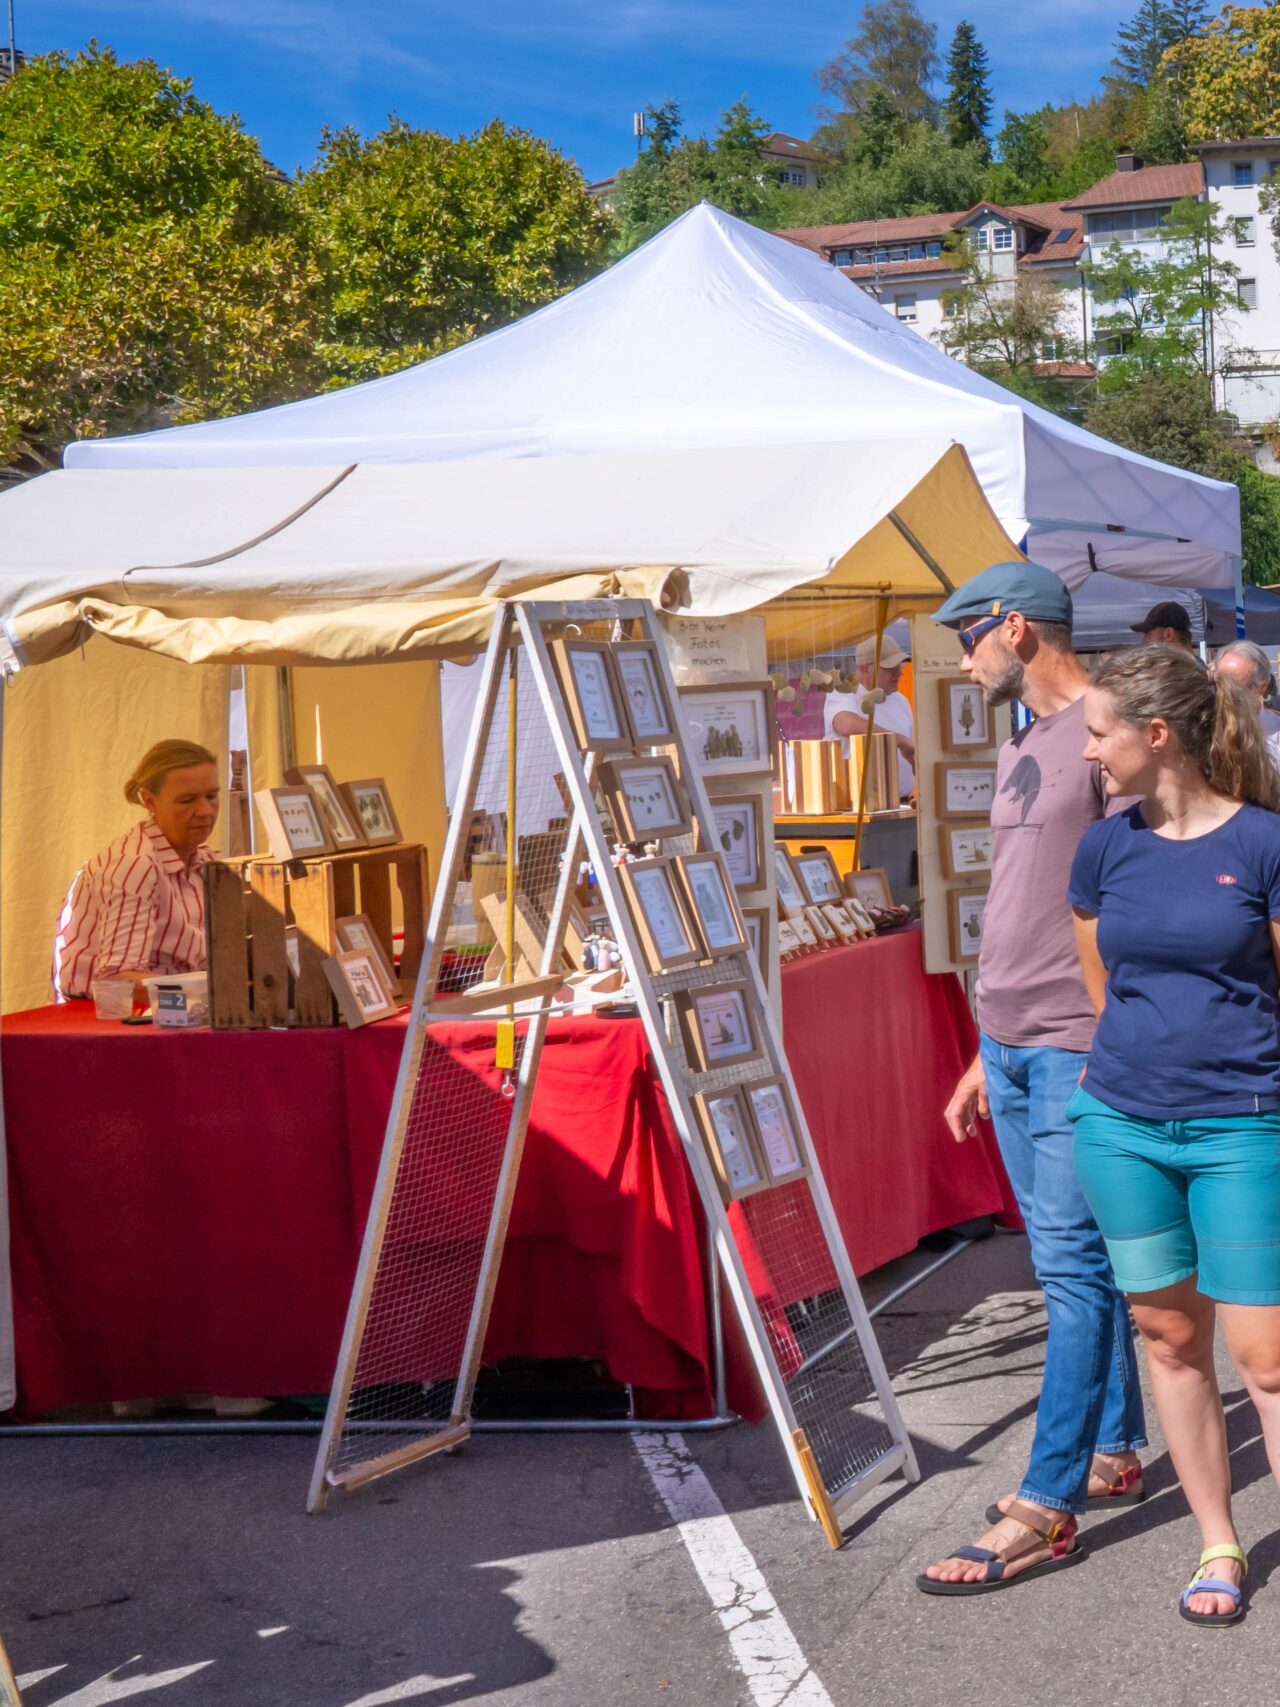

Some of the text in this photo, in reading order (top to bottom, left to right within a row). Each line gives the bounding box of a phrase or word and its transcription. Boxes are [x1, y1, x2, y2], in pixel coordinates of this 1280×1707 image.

[679, 620, 699, 632] Bitte
[689, 636, 721, 650] Fotos
[692, 657, 728, 666] machen
[176, 994, 185, 1007] 2
